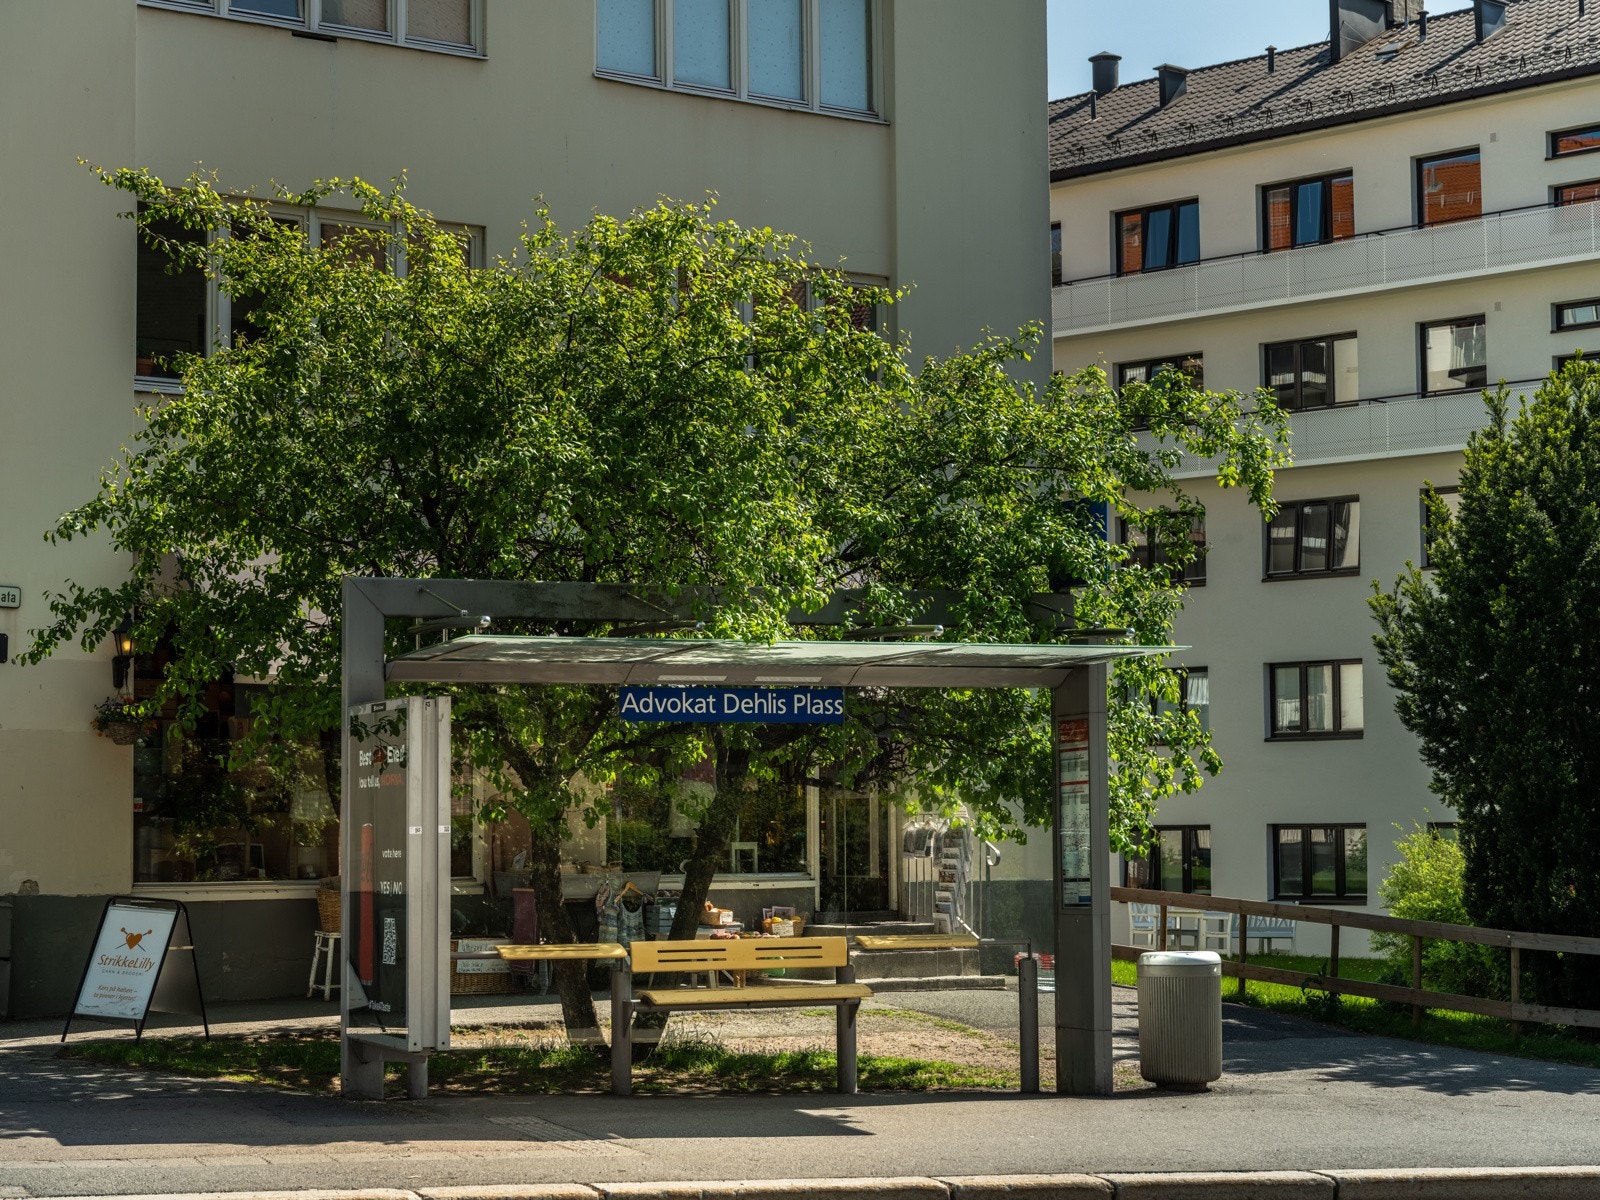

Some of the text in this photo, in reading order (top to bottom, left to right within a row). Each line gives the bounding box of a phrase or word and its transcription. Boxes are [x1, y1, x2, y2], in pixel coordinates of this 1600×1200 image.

[621, 692, 844, 714] Advokat Dehlis Plass
[382, 848, 402, 858] vote here
[380, 881, 390, 895] YES
[392, 881, 402, 895] NO
[97, 954, 155, 973] StrikkeLilly
